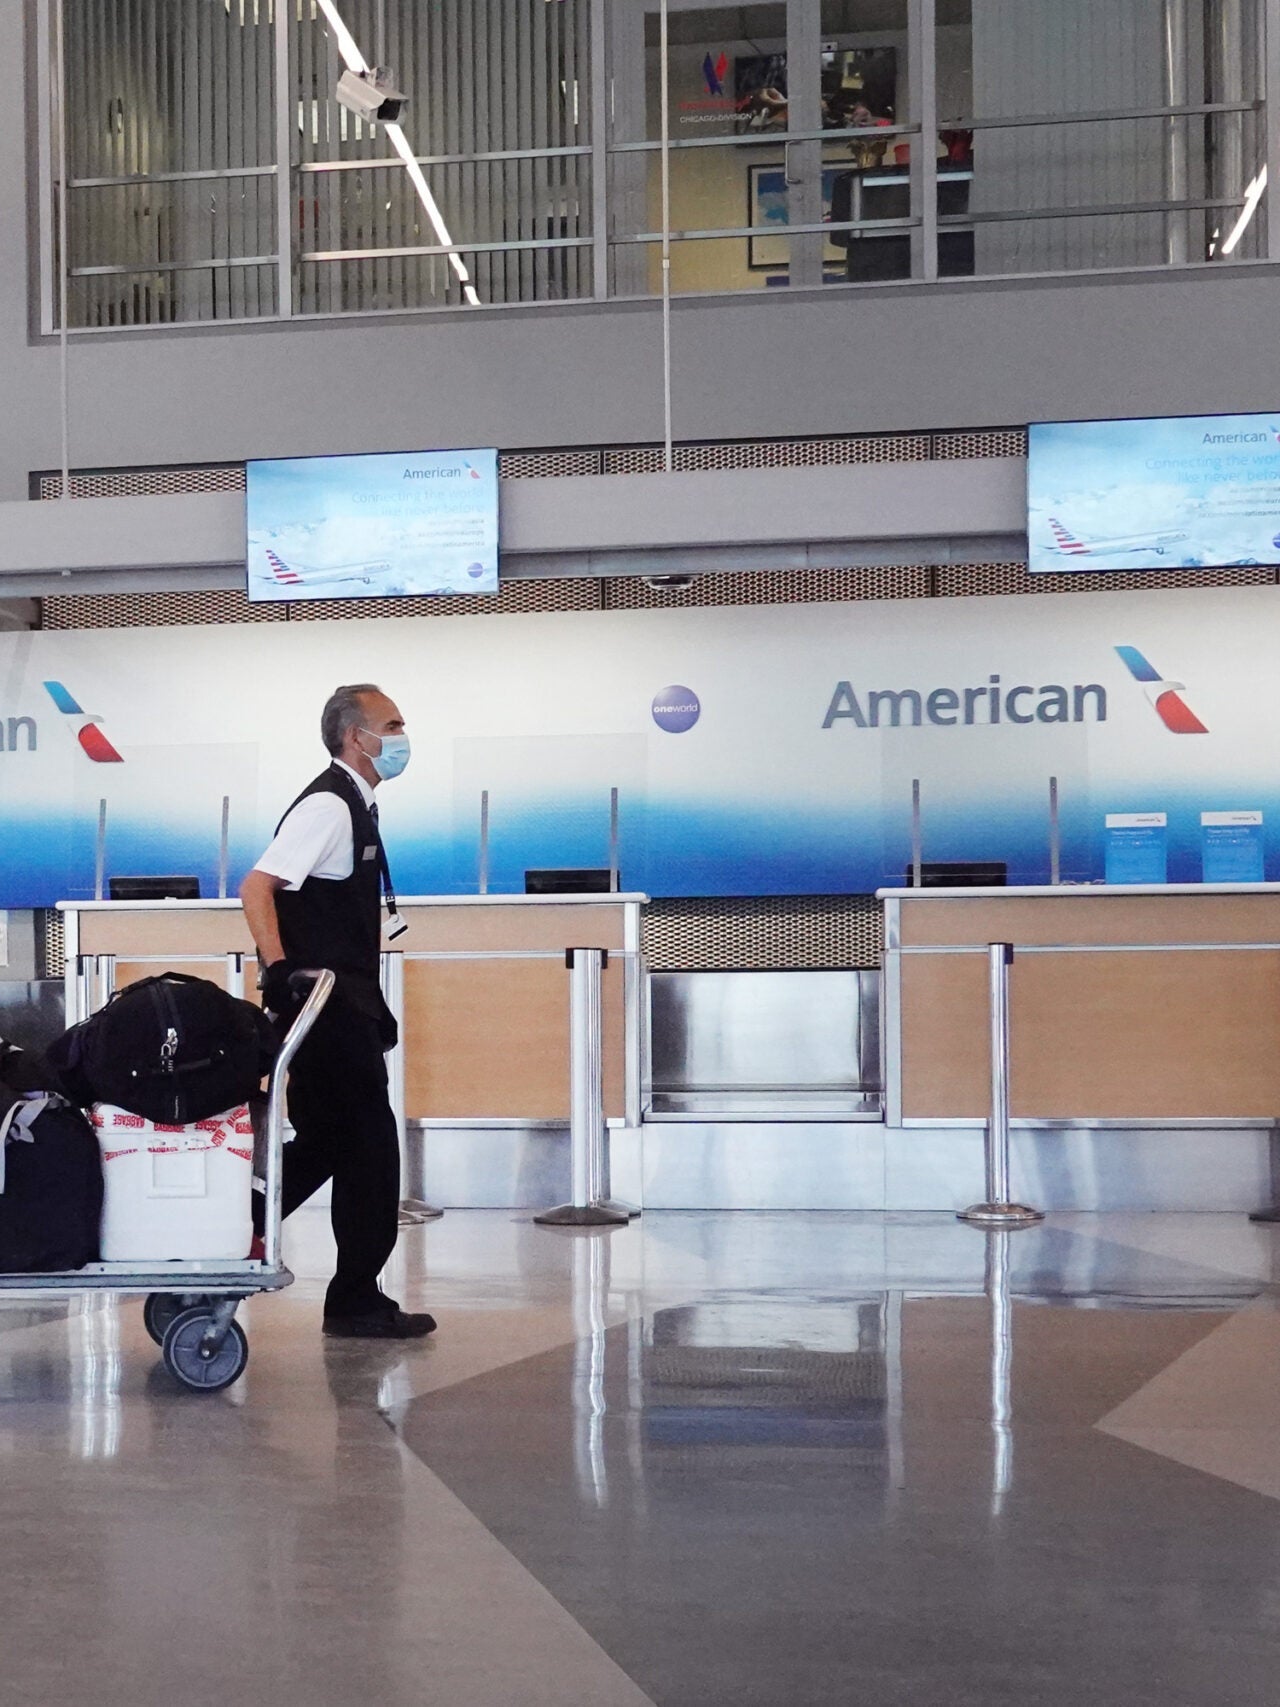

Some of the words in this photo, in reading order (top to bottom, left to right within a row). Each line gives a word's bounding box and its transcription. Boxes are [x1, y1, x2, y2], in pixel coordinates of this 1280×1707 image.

[1202, 432, 1267, 444] American
[1252, 452, 1280, 465] wor
[403, 467, 461, 479] American
[1247, 469, 1280, 481] befo
[822, 674, 1107, 729] American
[653, 703, 698, 713] oneworld
[113, 1114, 145, 1128] BAGGAGE
